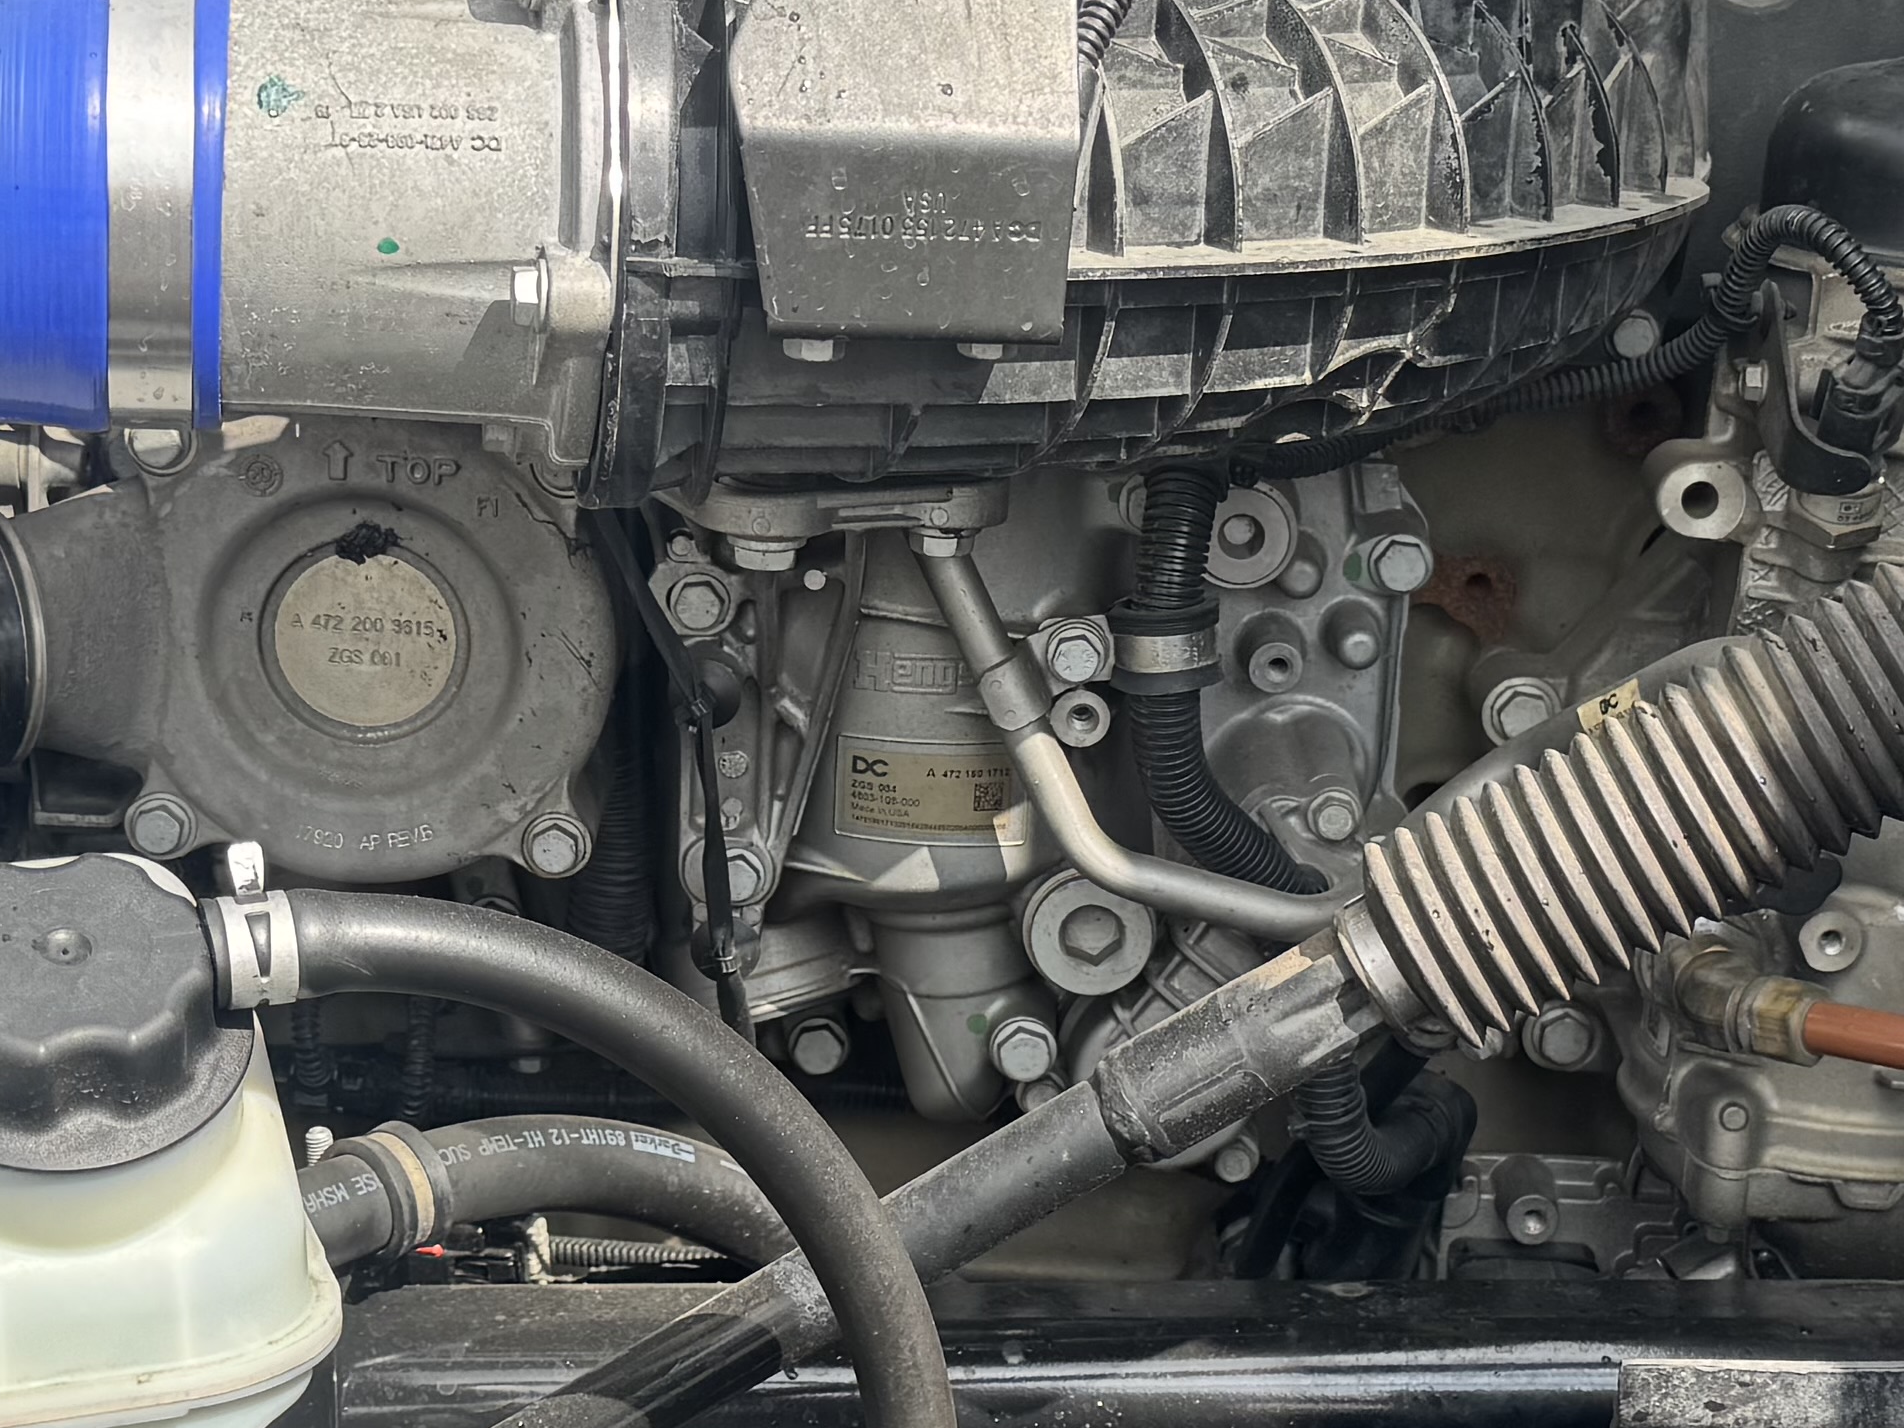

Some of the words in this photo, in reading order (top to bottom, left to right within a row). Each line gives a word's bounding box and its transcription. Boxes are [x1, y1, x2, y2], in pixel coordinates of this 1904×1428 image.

[902, 190, 945, 214] USA
[377, 454, 462, 486] TOP
[291, 613, 304, 628] A
[310, 614, 344, 632] 472
[352, 615, 384, 633] 200
[328, 647, 363, 665] ZGS
[1599, 693, 1618, 715] DC
[852, 754, 889, 778] DC
[926, 768, 936, 778] A
[942, 769, 961, 779] 472
[851, 801, 876, 814] Made
[360, 834, 381, 850] AP
[476, 1128, 544, 1153] HI-TEMP
[547, 1127, 625, 1145] 891HT-12
[630, 1131, 681, 1157] Parker
